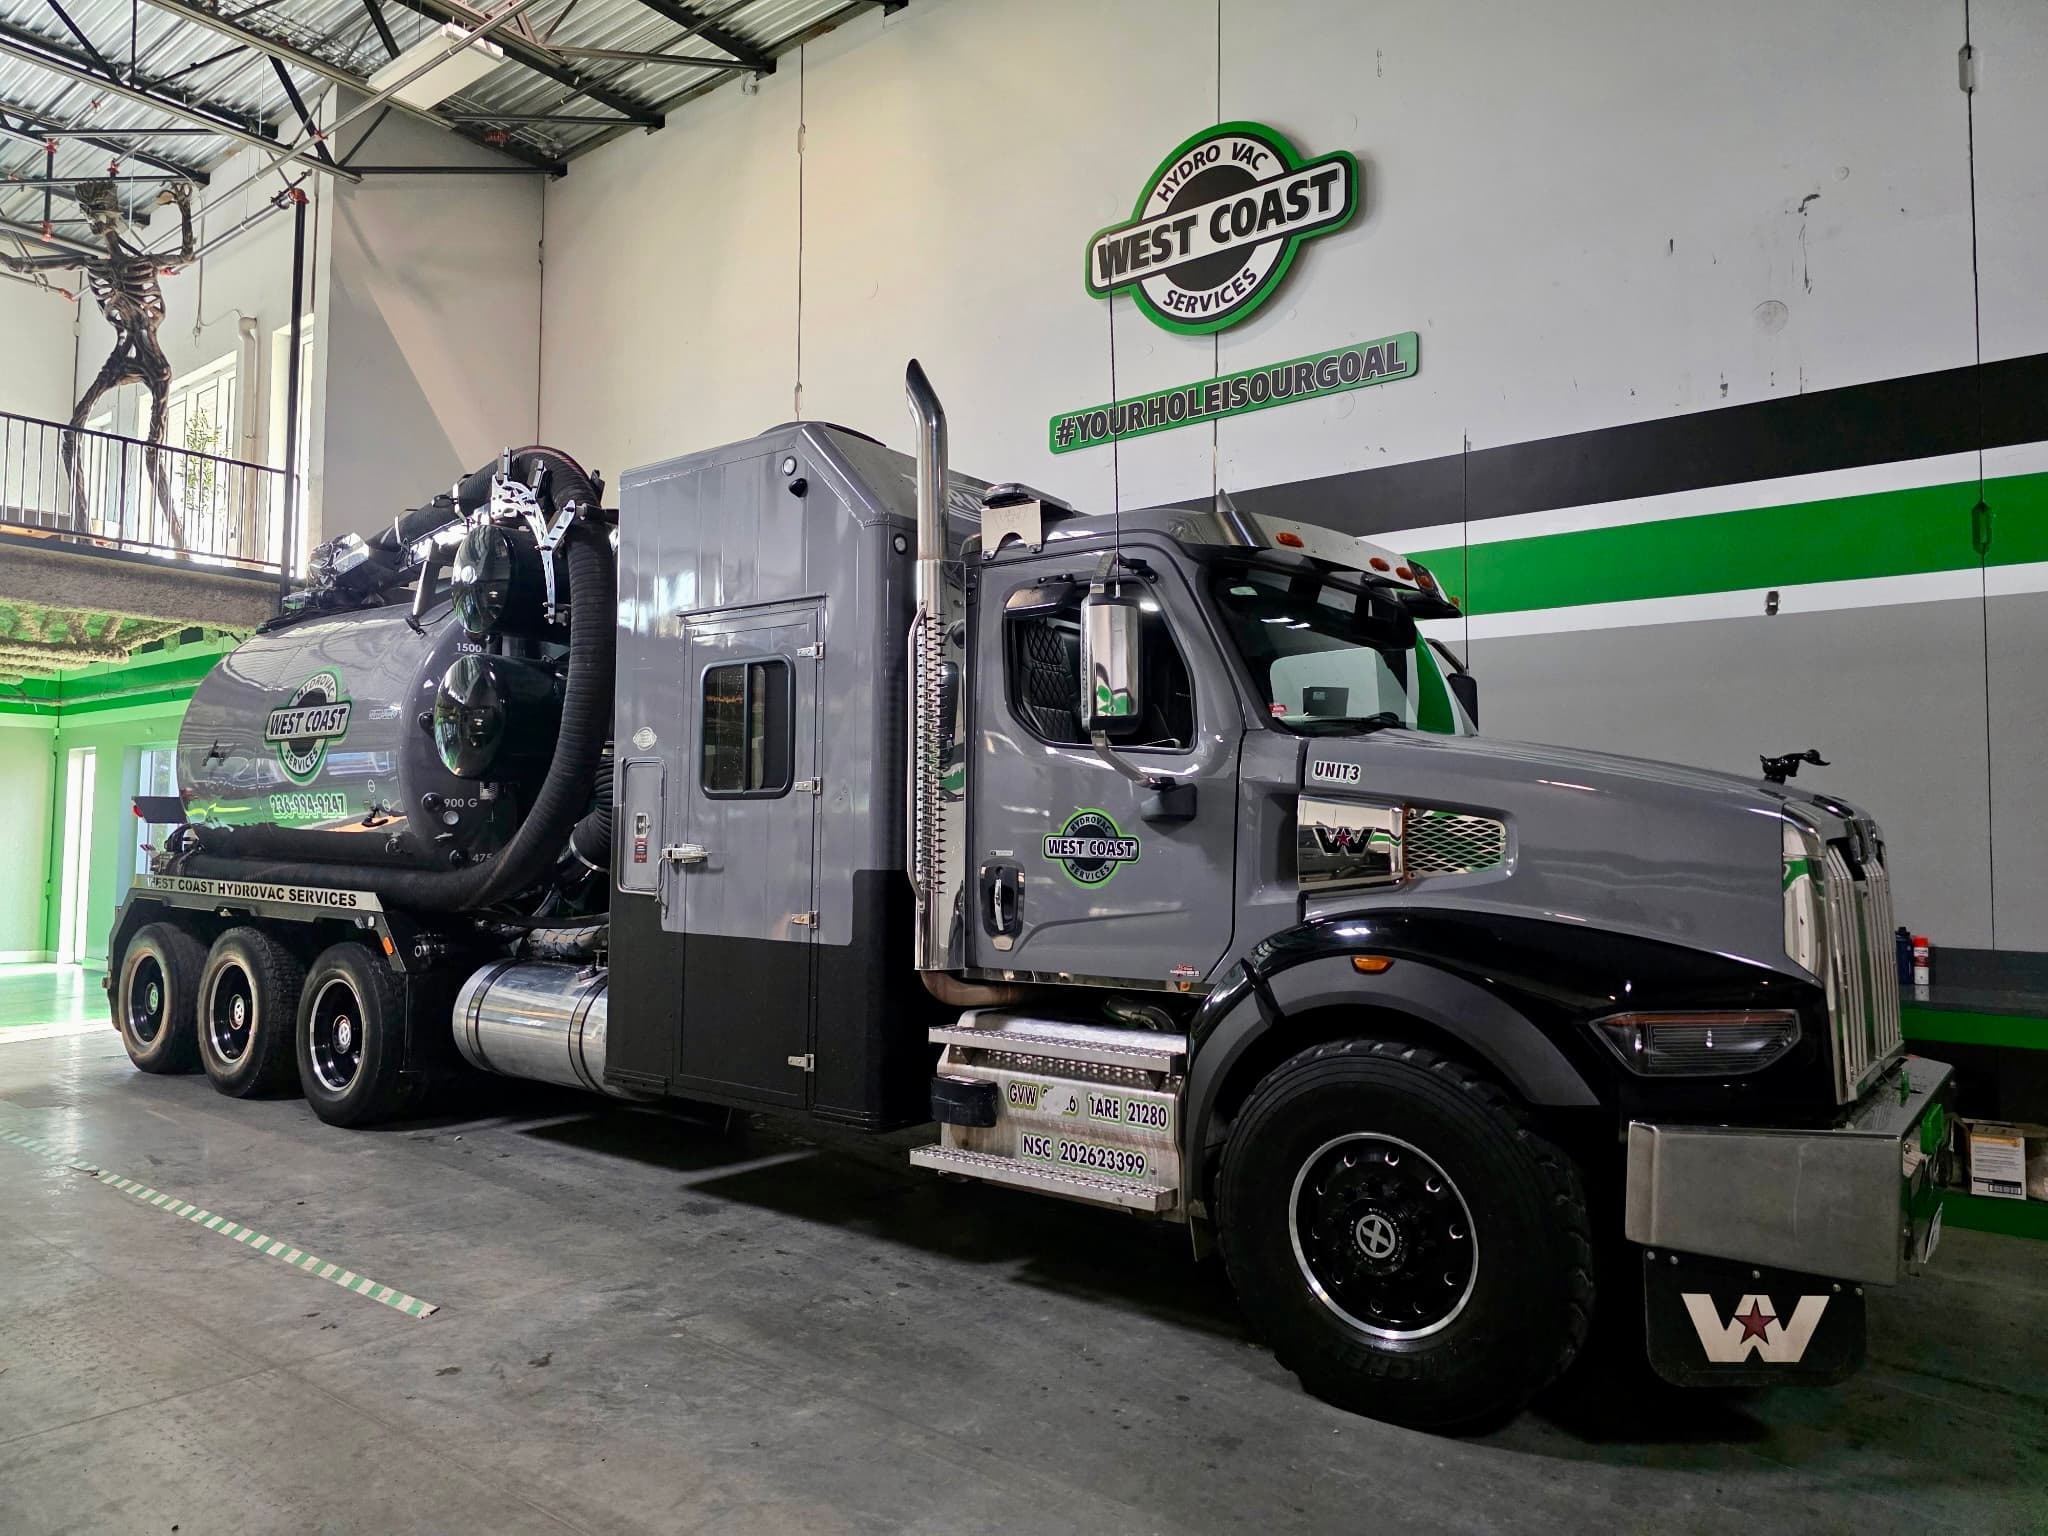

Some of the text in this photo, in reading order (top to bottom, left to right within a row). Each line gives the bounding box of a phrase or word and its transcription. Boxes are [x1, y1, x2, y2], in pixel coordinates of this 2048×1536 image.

[1157, 142, 1268, 202] HYDRO VAC
[1097, 168, 1339, 281] WEST COAST
[1163, 268, 1257, 313] SERVICES
[1055, 340, 1406, 447] #YOURHOLEISOURGOAL
[456, 642, 482, 653] 1500
[297, 675, 335, 699] HYDROVAC
[270, 711, 305, 735] WEST
[305, 708, 347, 732] COAST
[284, 747, 318, 771] SERVICES
[443, 798, 478, 808] 900 G
[1070, 816, 1111, 833] HYDROVAC
[1048, 839, 1134, 857] WEST COAST
[1069, 863, 1110, 880] SERVICES
[178, 879, 214, 894] COAST
[217, 883, 285, 900] HYDROVAC
[288, 888, 357, 907] SERVICES
[1009, 1083, 1037, 1106] GVW
[1089, 1095, 1120, 1120] TARE
[1127, 1102, 1167, 1127] 21280
[1023, 1135, 1145, 1175] NSC 202623399
